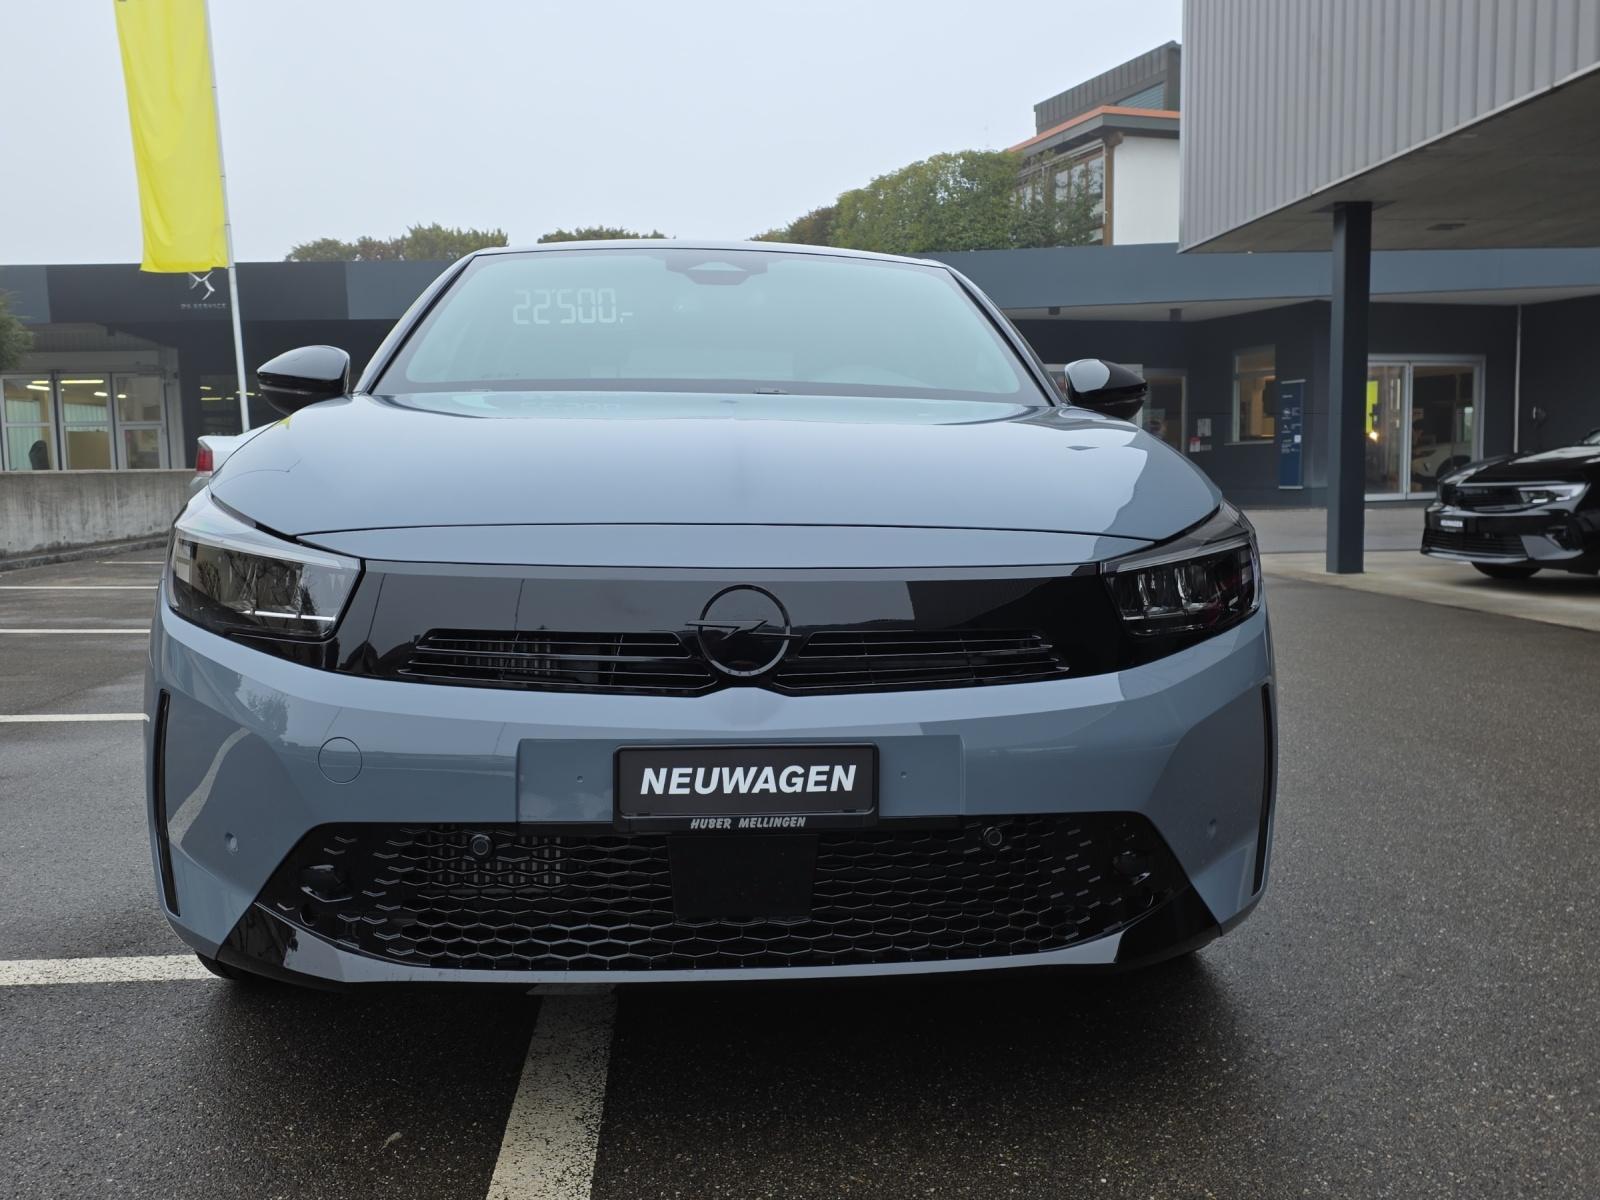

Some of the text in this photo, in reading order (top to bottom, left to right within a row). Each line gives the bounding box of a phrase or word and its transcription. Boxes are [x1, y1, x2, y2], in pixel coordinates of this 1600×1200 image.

[640, 764, 856, 795] NEUWAGEN
[690, 816, 806, 829] HUBER MELLINGEN
